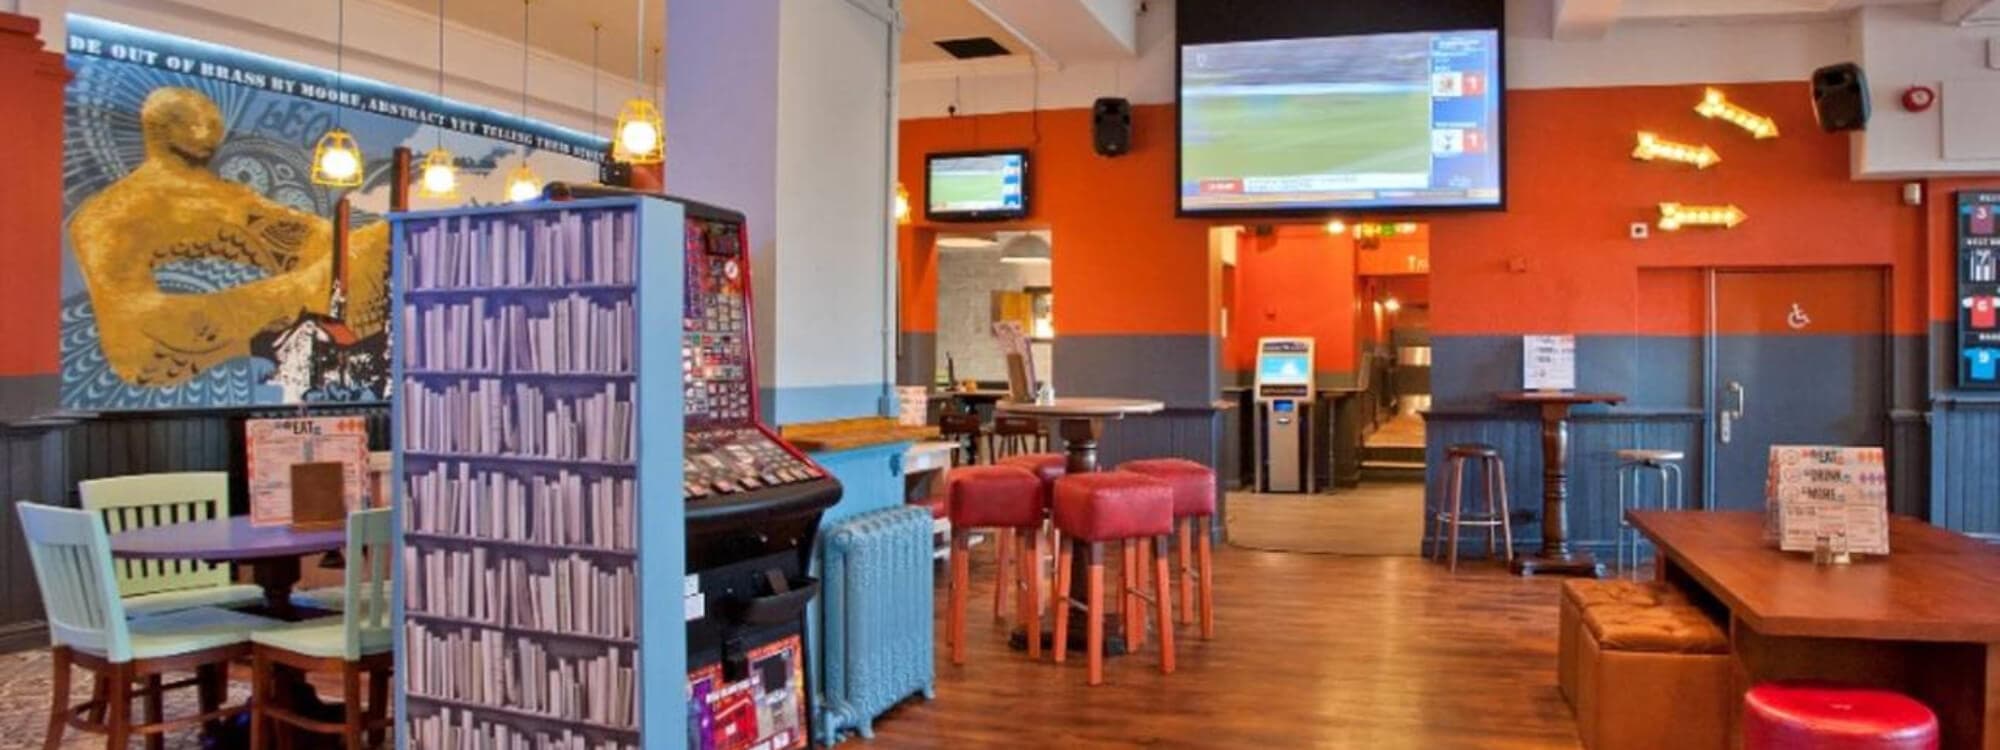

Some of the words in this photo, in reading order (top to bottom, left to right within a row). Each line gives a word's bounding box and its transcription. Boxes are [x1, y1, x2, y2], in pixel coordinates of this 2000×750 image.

[111, 44, 158, 65] OUT
[166, 56, 195, 73] OF
[200, 62, 266, 89] BRASS
[271, 76, 296, 94] BY
[368, 98, 444, 125] ABSTRACT
[451, 117, 477, 133] YET
[482, 124, 533, 145] TELLING
